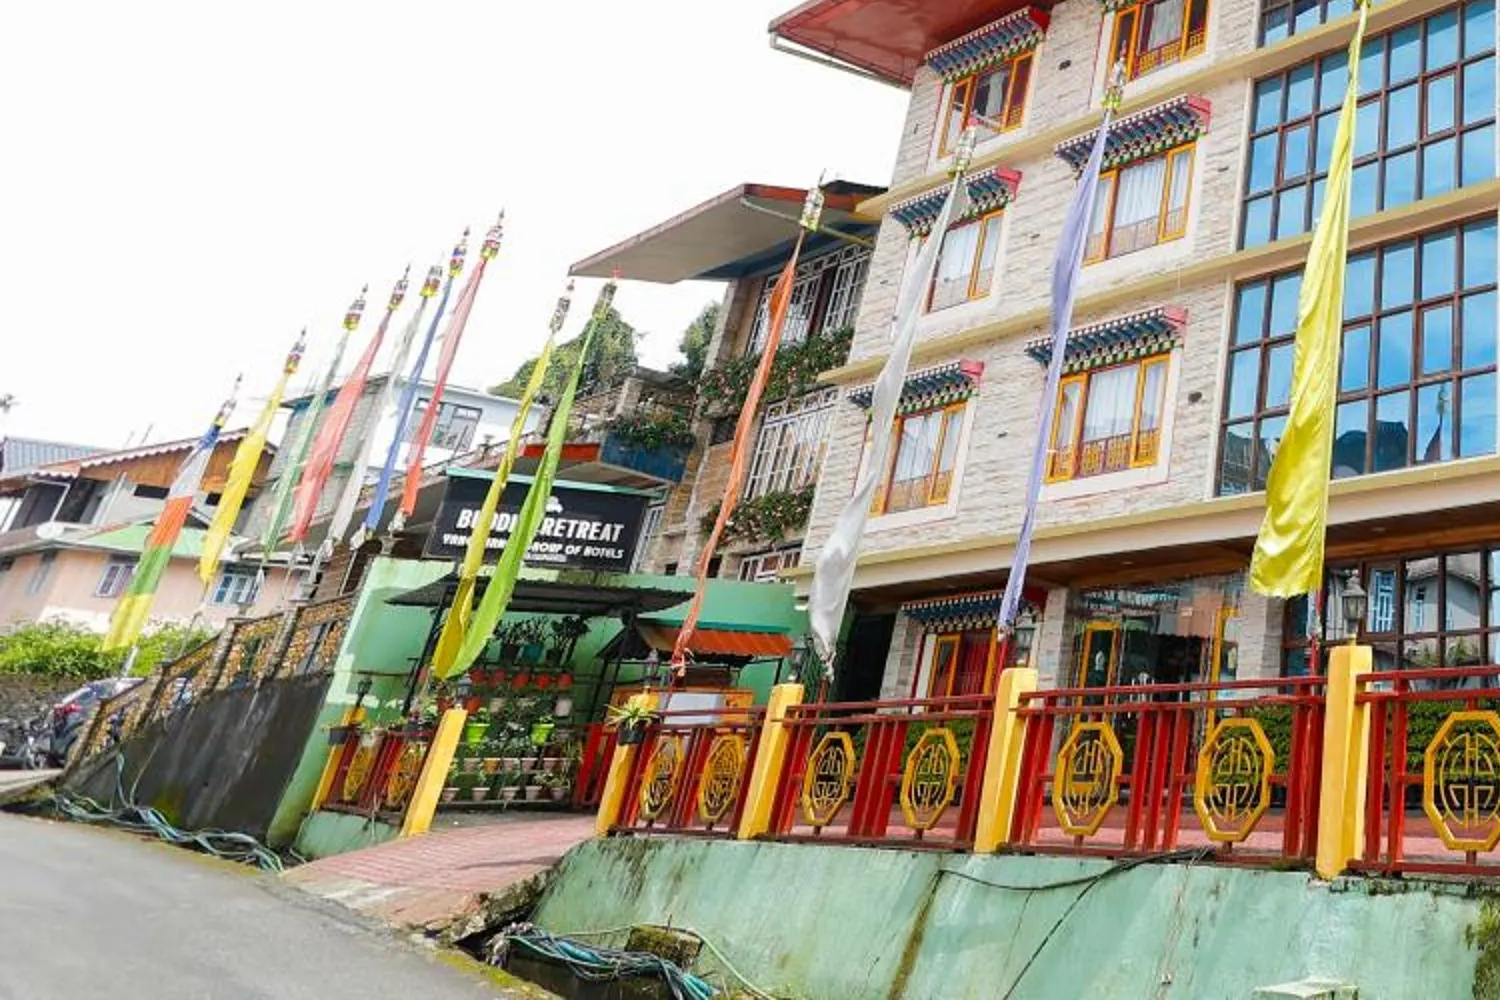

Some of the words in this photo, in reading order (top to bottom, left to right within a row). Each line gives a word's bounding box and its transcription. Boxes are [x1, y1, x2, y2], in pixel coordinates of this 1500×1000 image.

[539, 517, 625, 543] RETREAT
[527, 541, 564, 553] ROUP
[565, 544, 582, 556] OF
[583, 545, 625, 559] HOTELS
